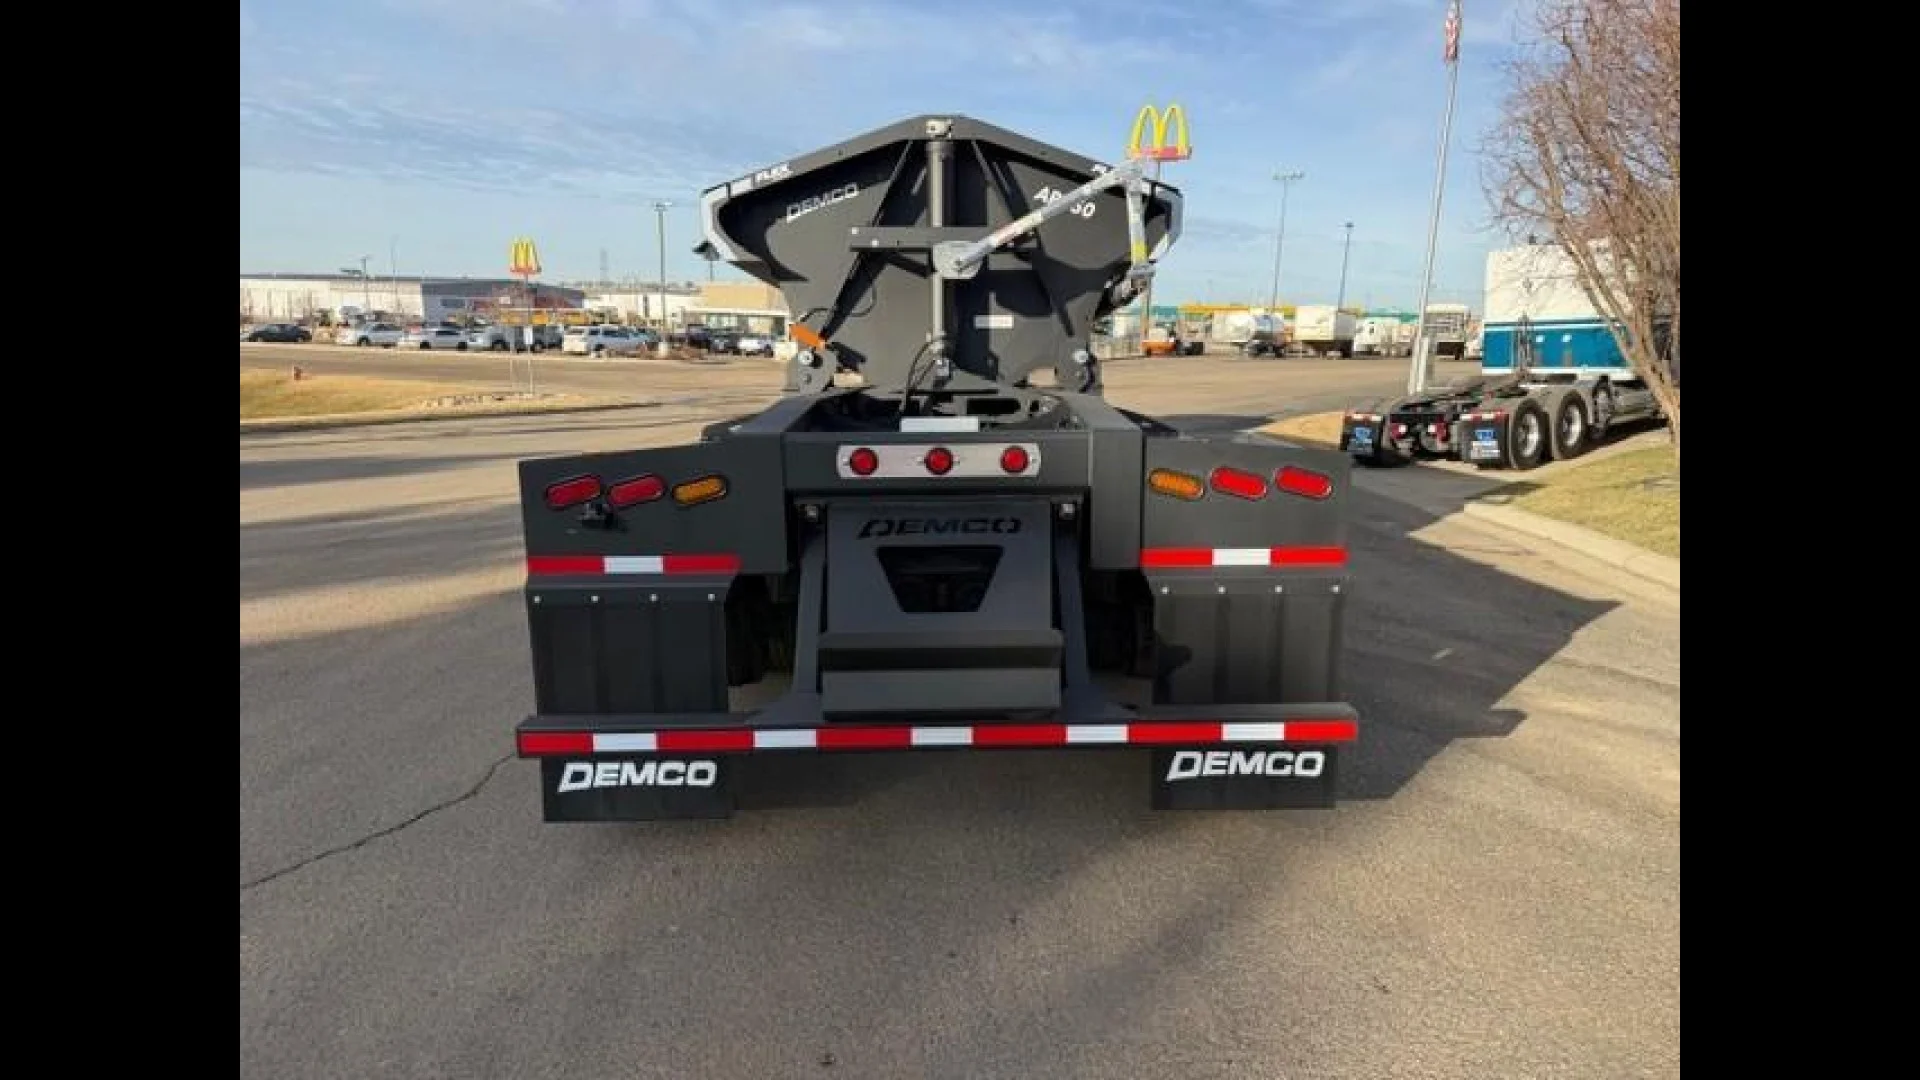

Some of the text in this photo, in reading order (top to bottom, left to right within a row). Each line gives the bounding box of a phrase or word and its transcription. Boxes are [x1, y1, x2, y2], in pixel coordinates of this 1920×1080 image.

[786, 183, 860, 223] DEMCO
[857, 517, 1022, 539] DEMCO
[557, 761, 717, 793] DEMCO
[1166, 750, 1325, 782] DEMCO
